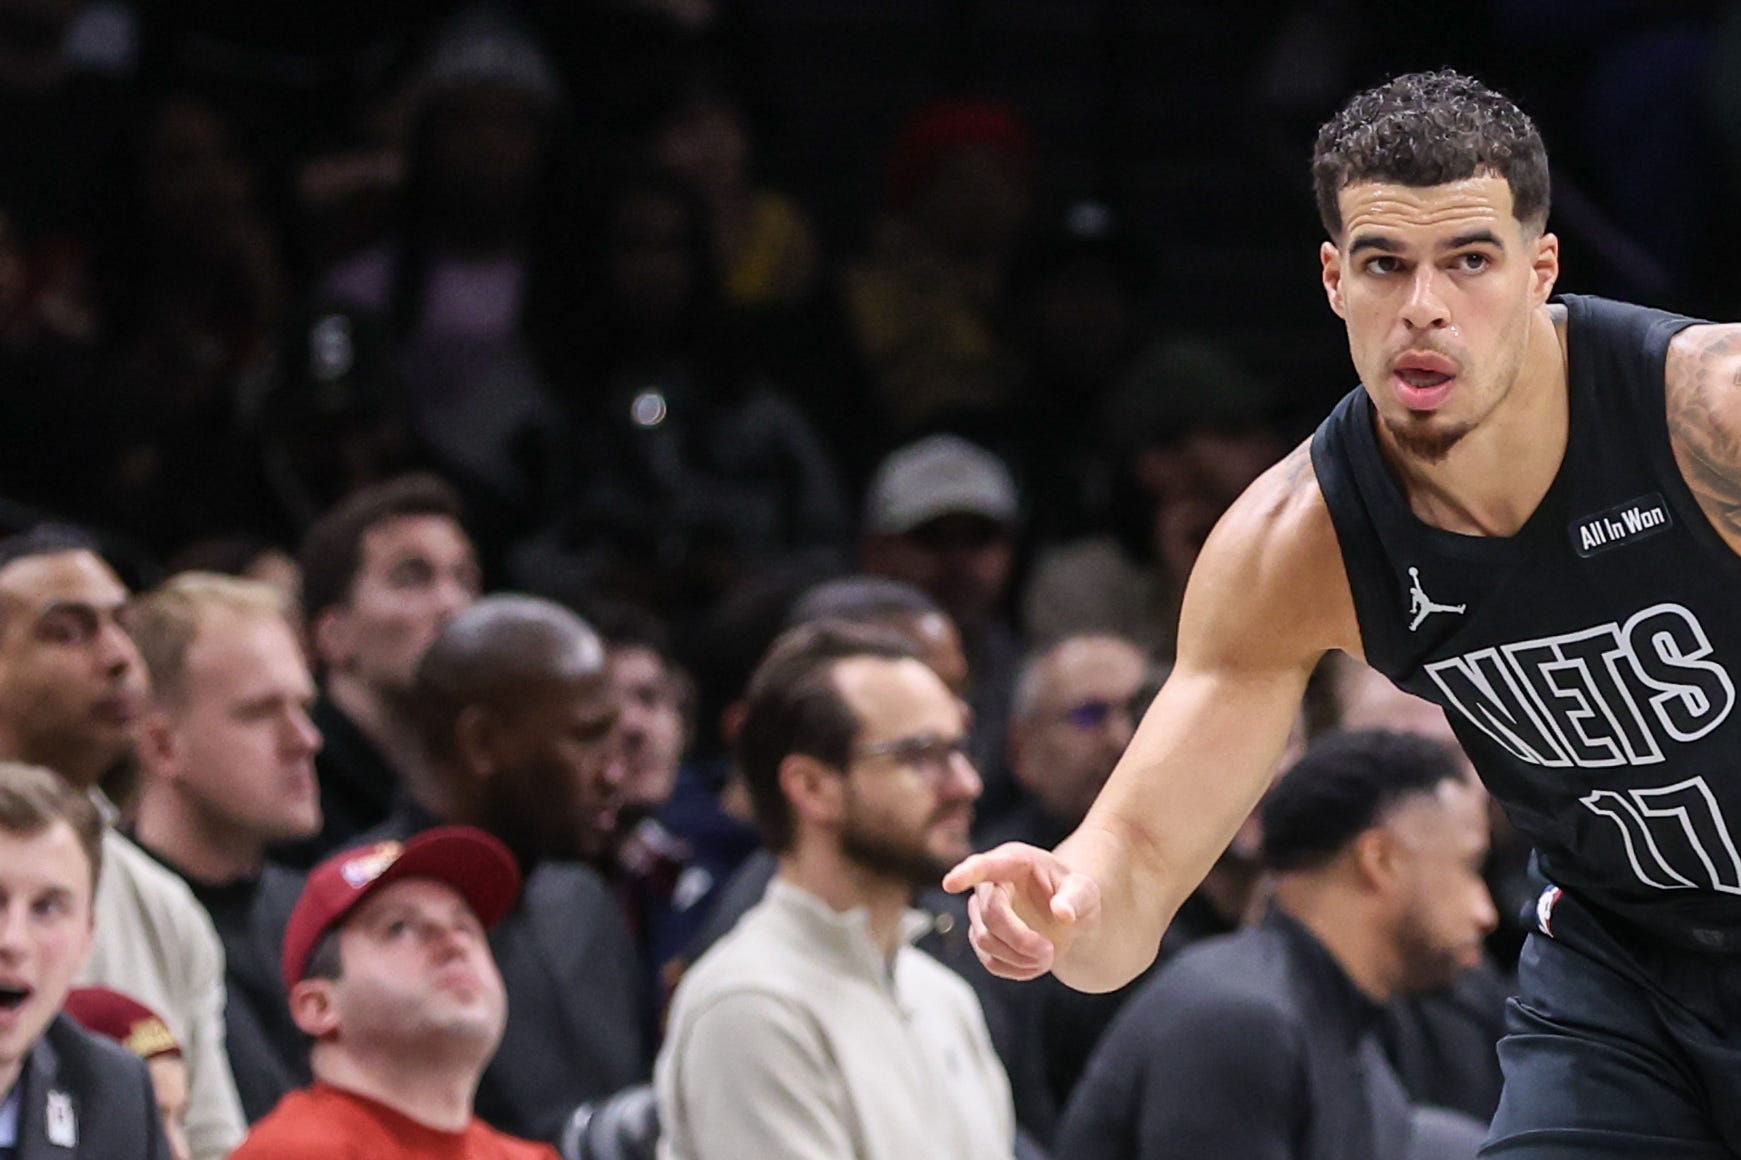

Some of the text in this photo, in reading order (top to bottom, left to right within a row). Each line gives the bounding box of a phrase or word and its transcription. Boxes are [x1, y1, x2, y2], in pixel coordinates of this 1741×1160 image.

[1580, 507, 1665, 550] All In Won
[1424, 603, 1736, 767] NETS
